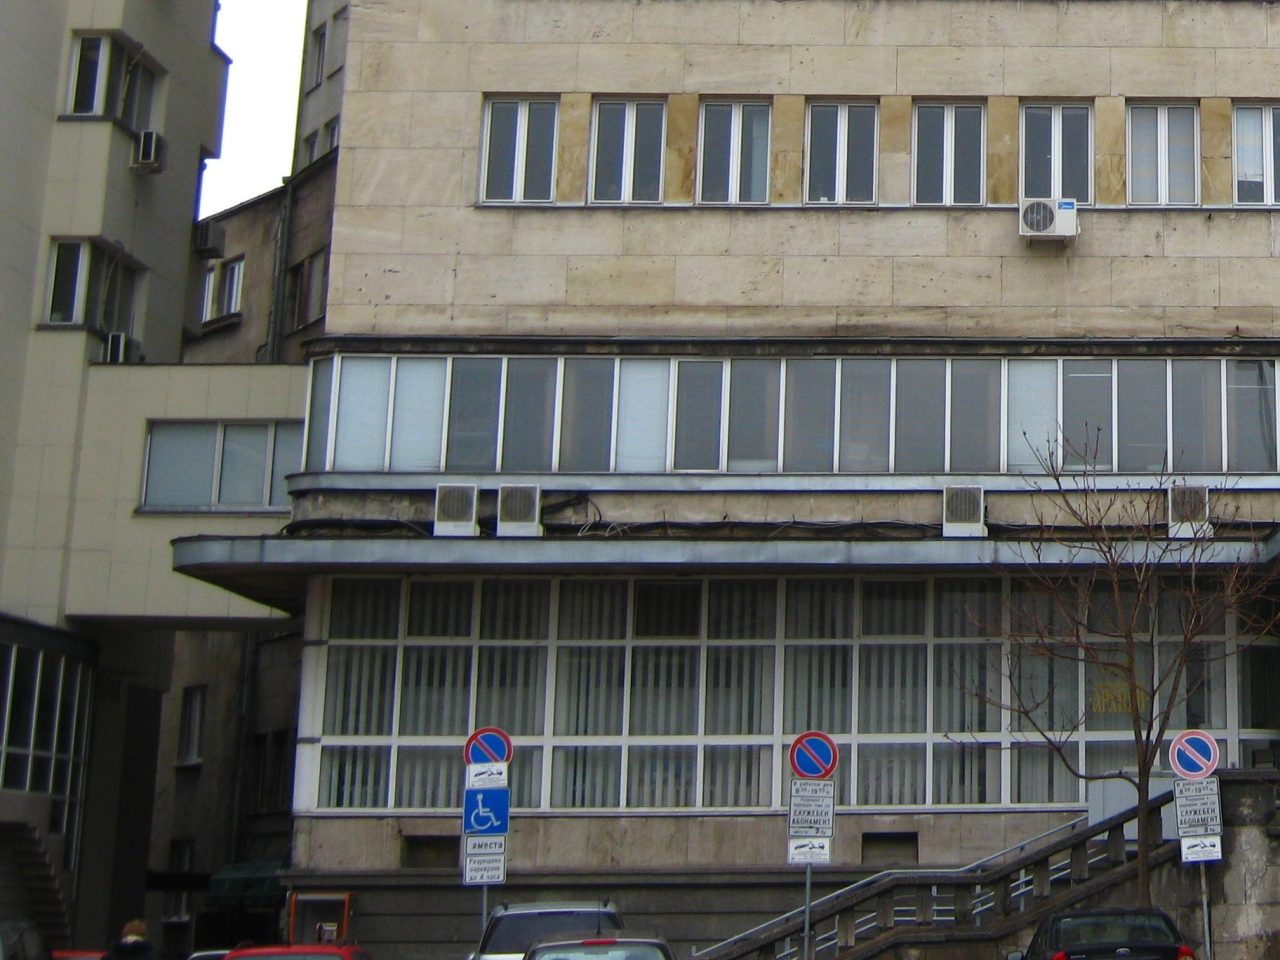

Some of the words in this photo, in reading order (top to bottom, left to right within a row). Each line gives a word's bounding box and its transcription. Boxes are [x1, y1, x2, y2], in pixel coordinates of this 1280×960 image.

[793, 809, 829, 817] СЛУЖЕБЕН
[1180, 808, 1216, 817] СЛУЖЕБЕН
[791, 817, 831, 826] АБОНАМЕНТ
[1180, 816, 1218, 825] АБОНАМЕНТ
